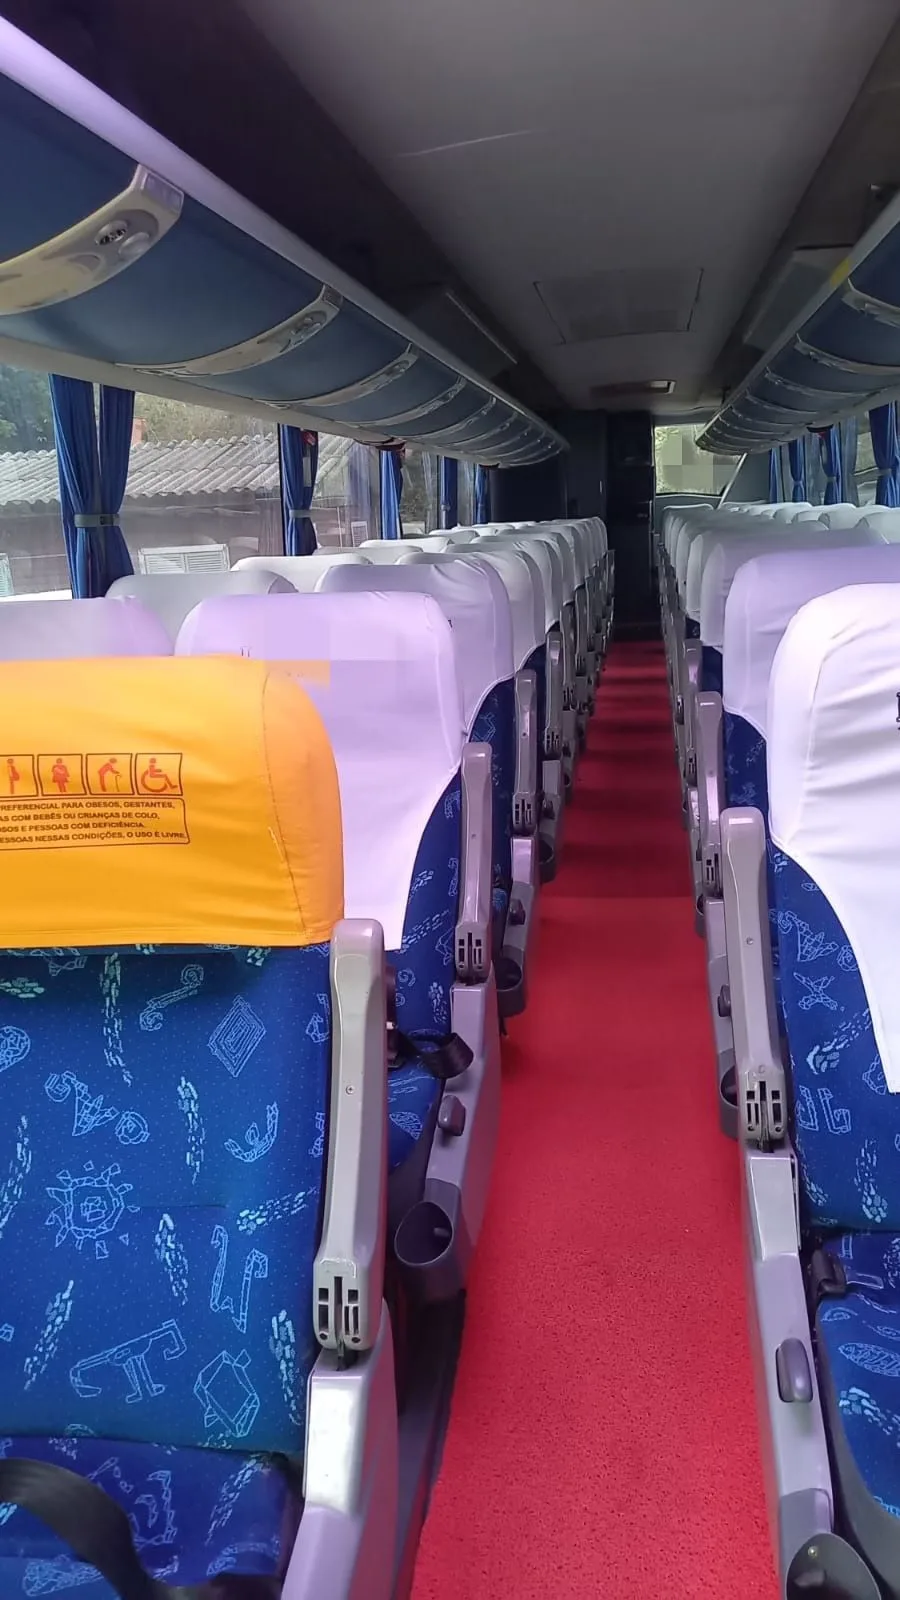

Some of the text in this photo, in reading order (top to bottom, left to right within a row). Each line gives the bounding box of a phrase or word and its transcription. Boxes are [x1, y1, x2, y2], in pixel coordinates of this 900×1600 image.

[0, 803, 60, 811] REFERENCIAL
[85, 801, 122, 809] OBESOS,
[123, 801, 175, 809] GESTANTES,
[77, 812, 120, 820] CRIANÇAS
[29, 823, 69, 832] PESSOAS
[35, 834, 70, 842] NESSAS
